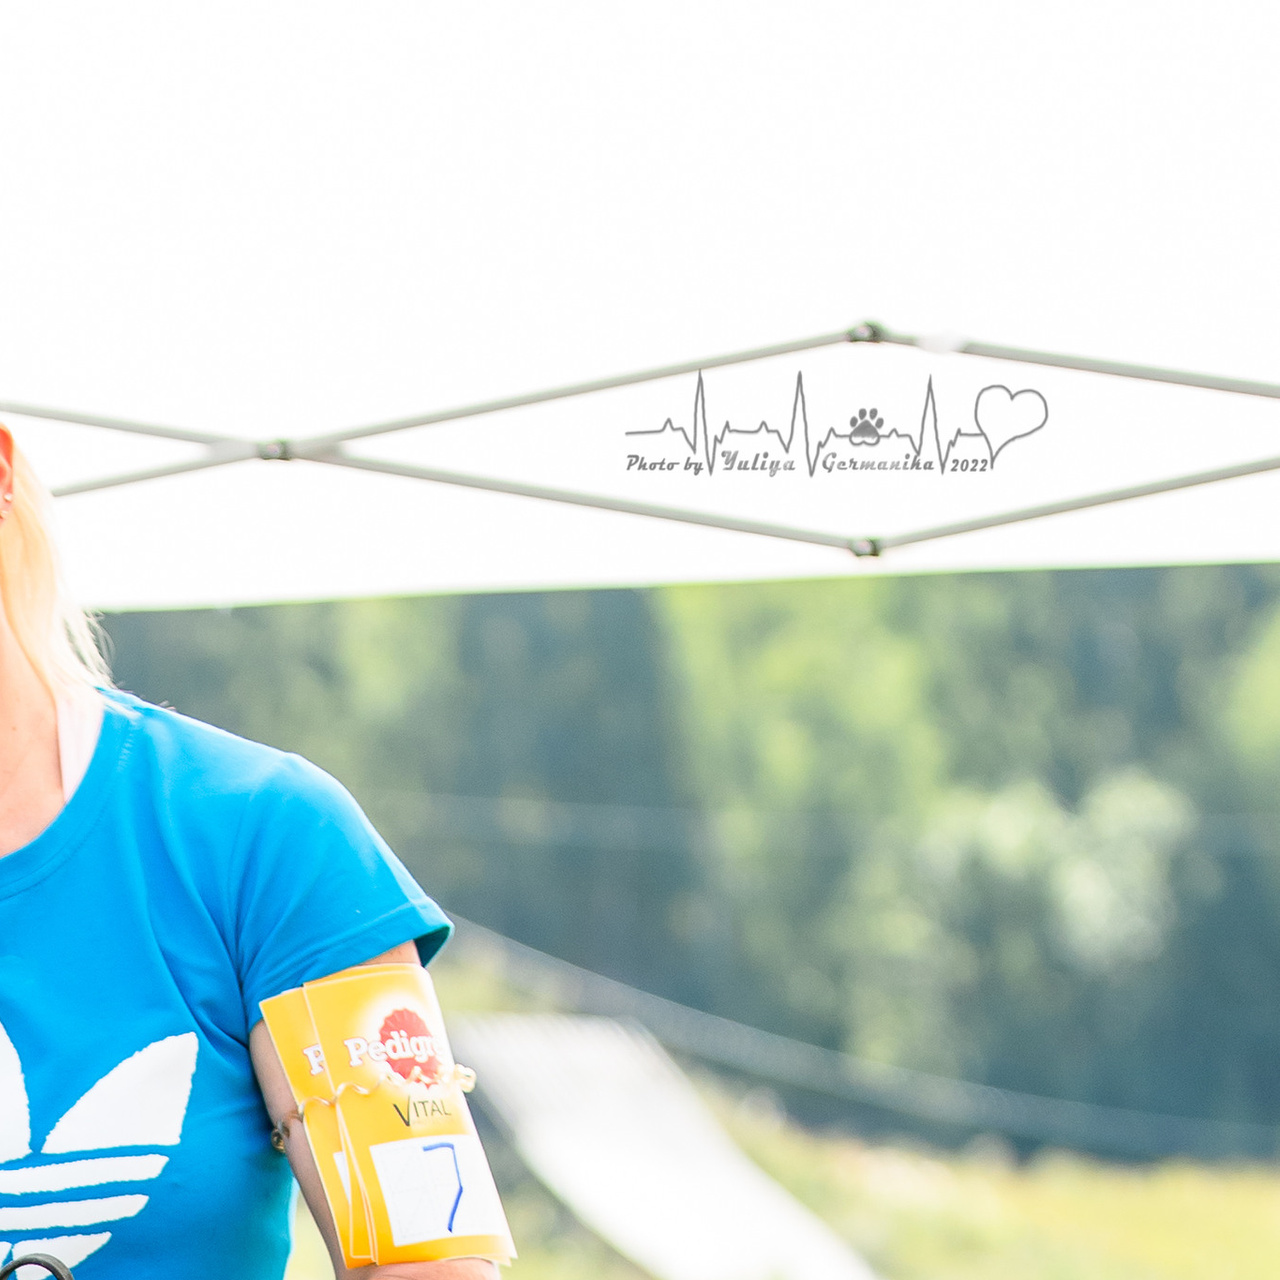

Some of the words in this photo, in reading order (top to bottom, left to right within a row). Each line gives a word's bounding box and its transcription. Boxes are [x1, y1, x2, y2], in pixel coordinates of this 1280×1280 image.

[343, 1029, 443, 1067] Pedigr
[393, 1095, 452, 1126] VITAL
[422, 1142, 463, 1233] 7
